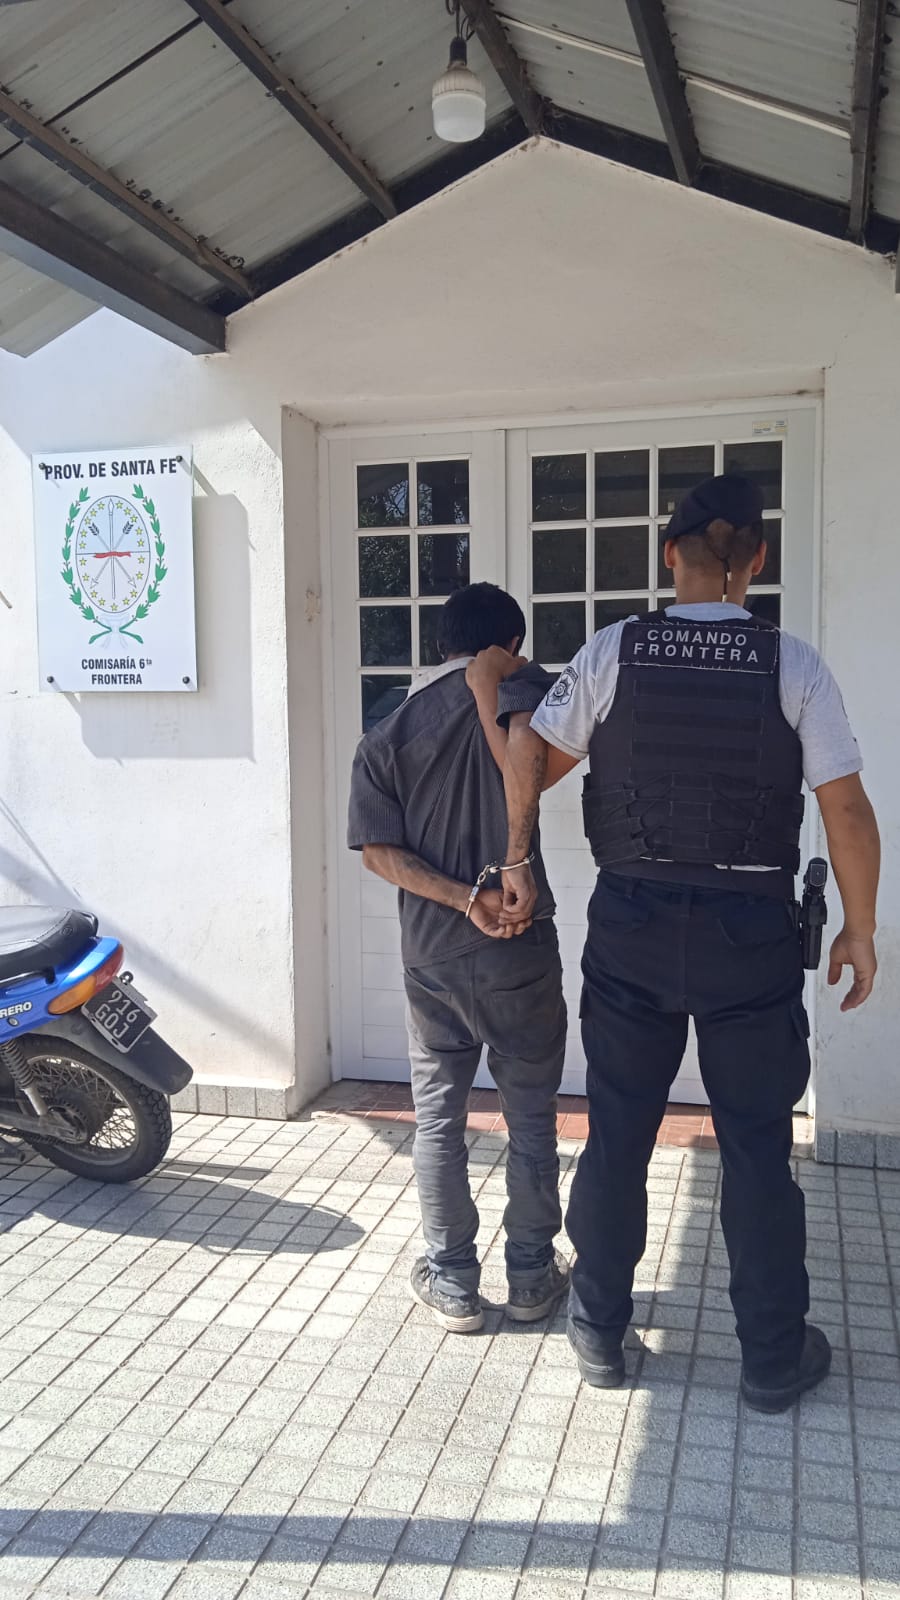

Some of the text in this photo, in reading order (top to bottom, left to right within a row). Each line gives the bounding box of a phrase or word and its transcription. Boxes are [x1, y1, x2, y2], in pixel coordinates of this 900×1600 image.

[45, 458, 177, 480] PROV. DE SANTA FE
[647, 629, 747, 646] COMANDO
[81, 656, 136, 670] COMISARÍA
[633, 642, 758, 663] FRONTERA
[91, 673, 142, 685] FRONTERA
[107, 989, 141, 1023] 916
[95, 1003, 130, 1039] GOJ
